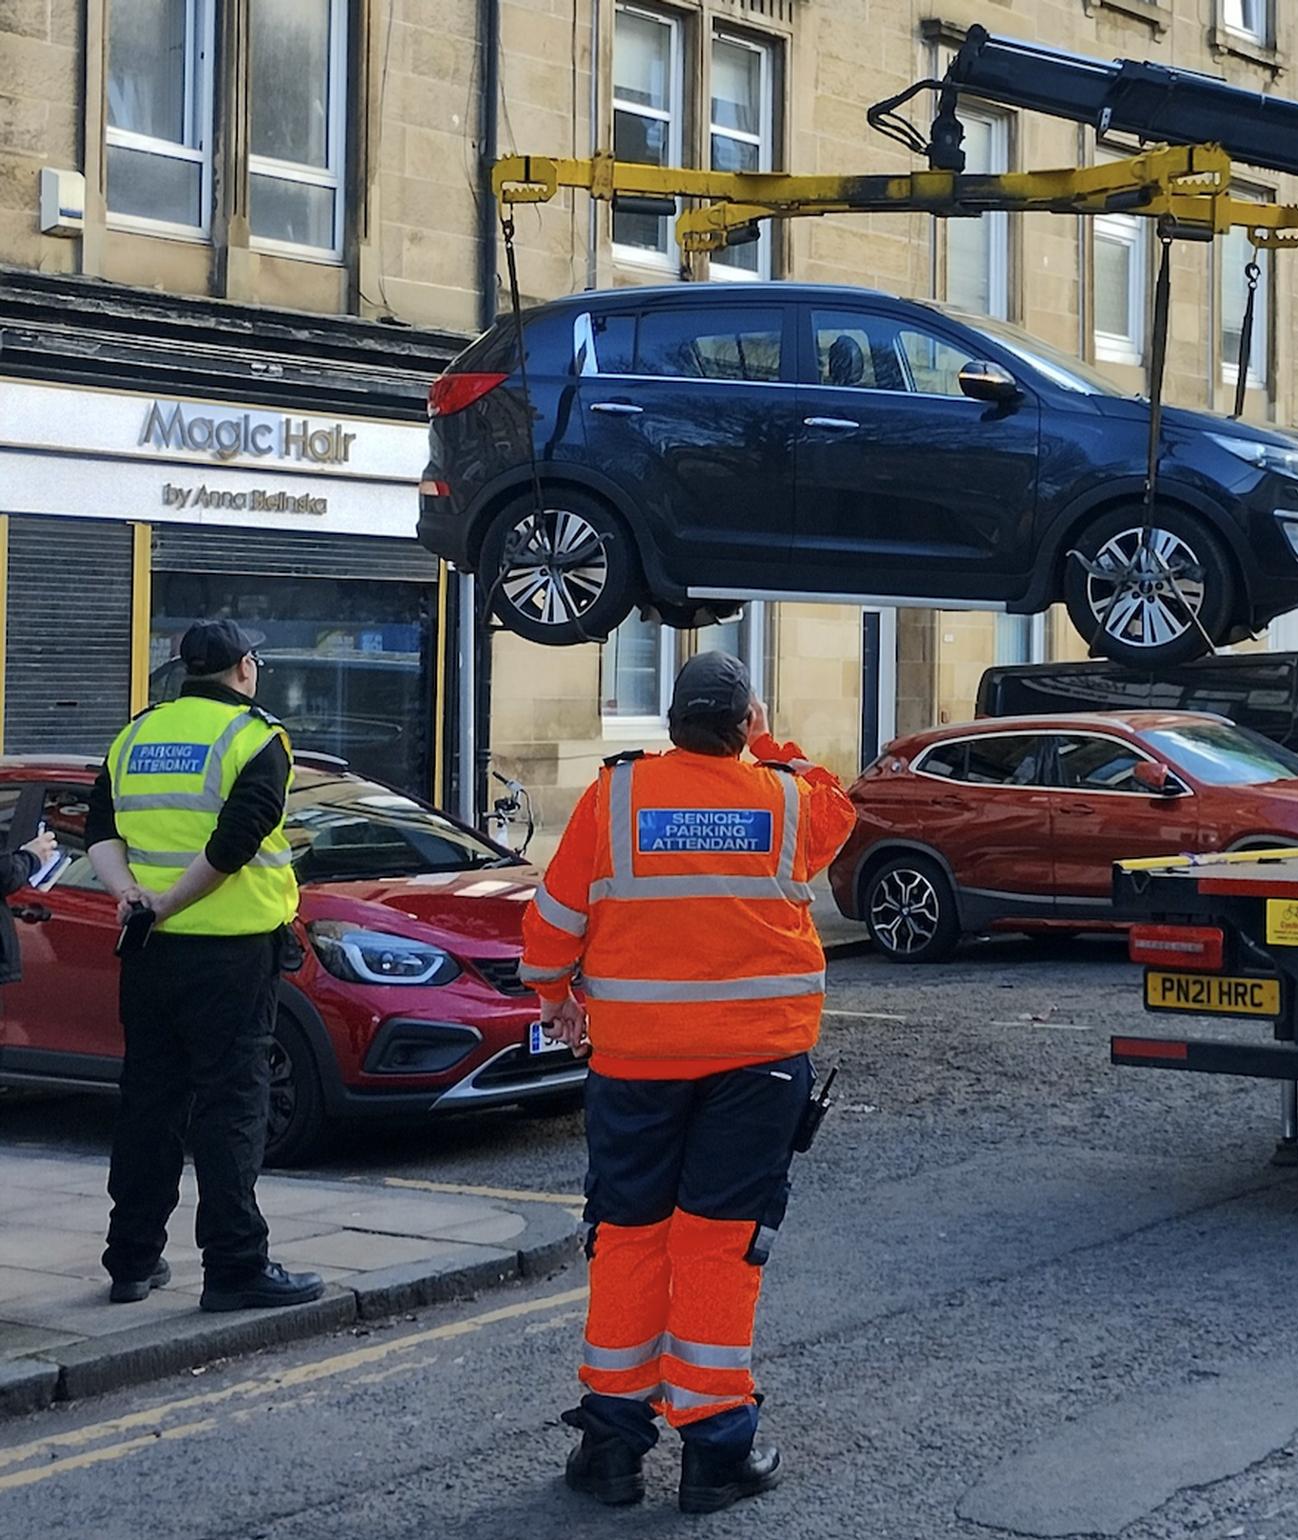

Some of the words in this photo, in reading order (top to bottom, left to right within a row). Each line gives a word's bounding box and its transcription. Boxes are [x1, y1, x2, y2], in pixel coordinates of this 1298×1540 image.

[138, 401, 274, 461] Magic
[279, 417, 356, 465] Hair
[162, 482, 192, 510] by
[193, 484, 247, 511] Anna
[139, 745, 193, 758] PARKING
[129, 759, 200, 773] ATTENDANT
[672, 812, 740, 825] SENIOR
[666, 825, 746, 838] PARKING
[652, 838, 758, 851] ATTENDANT
[1161, 976, 1212, 1005] PN21
[1218, 982, 1264, 1008] HRC
